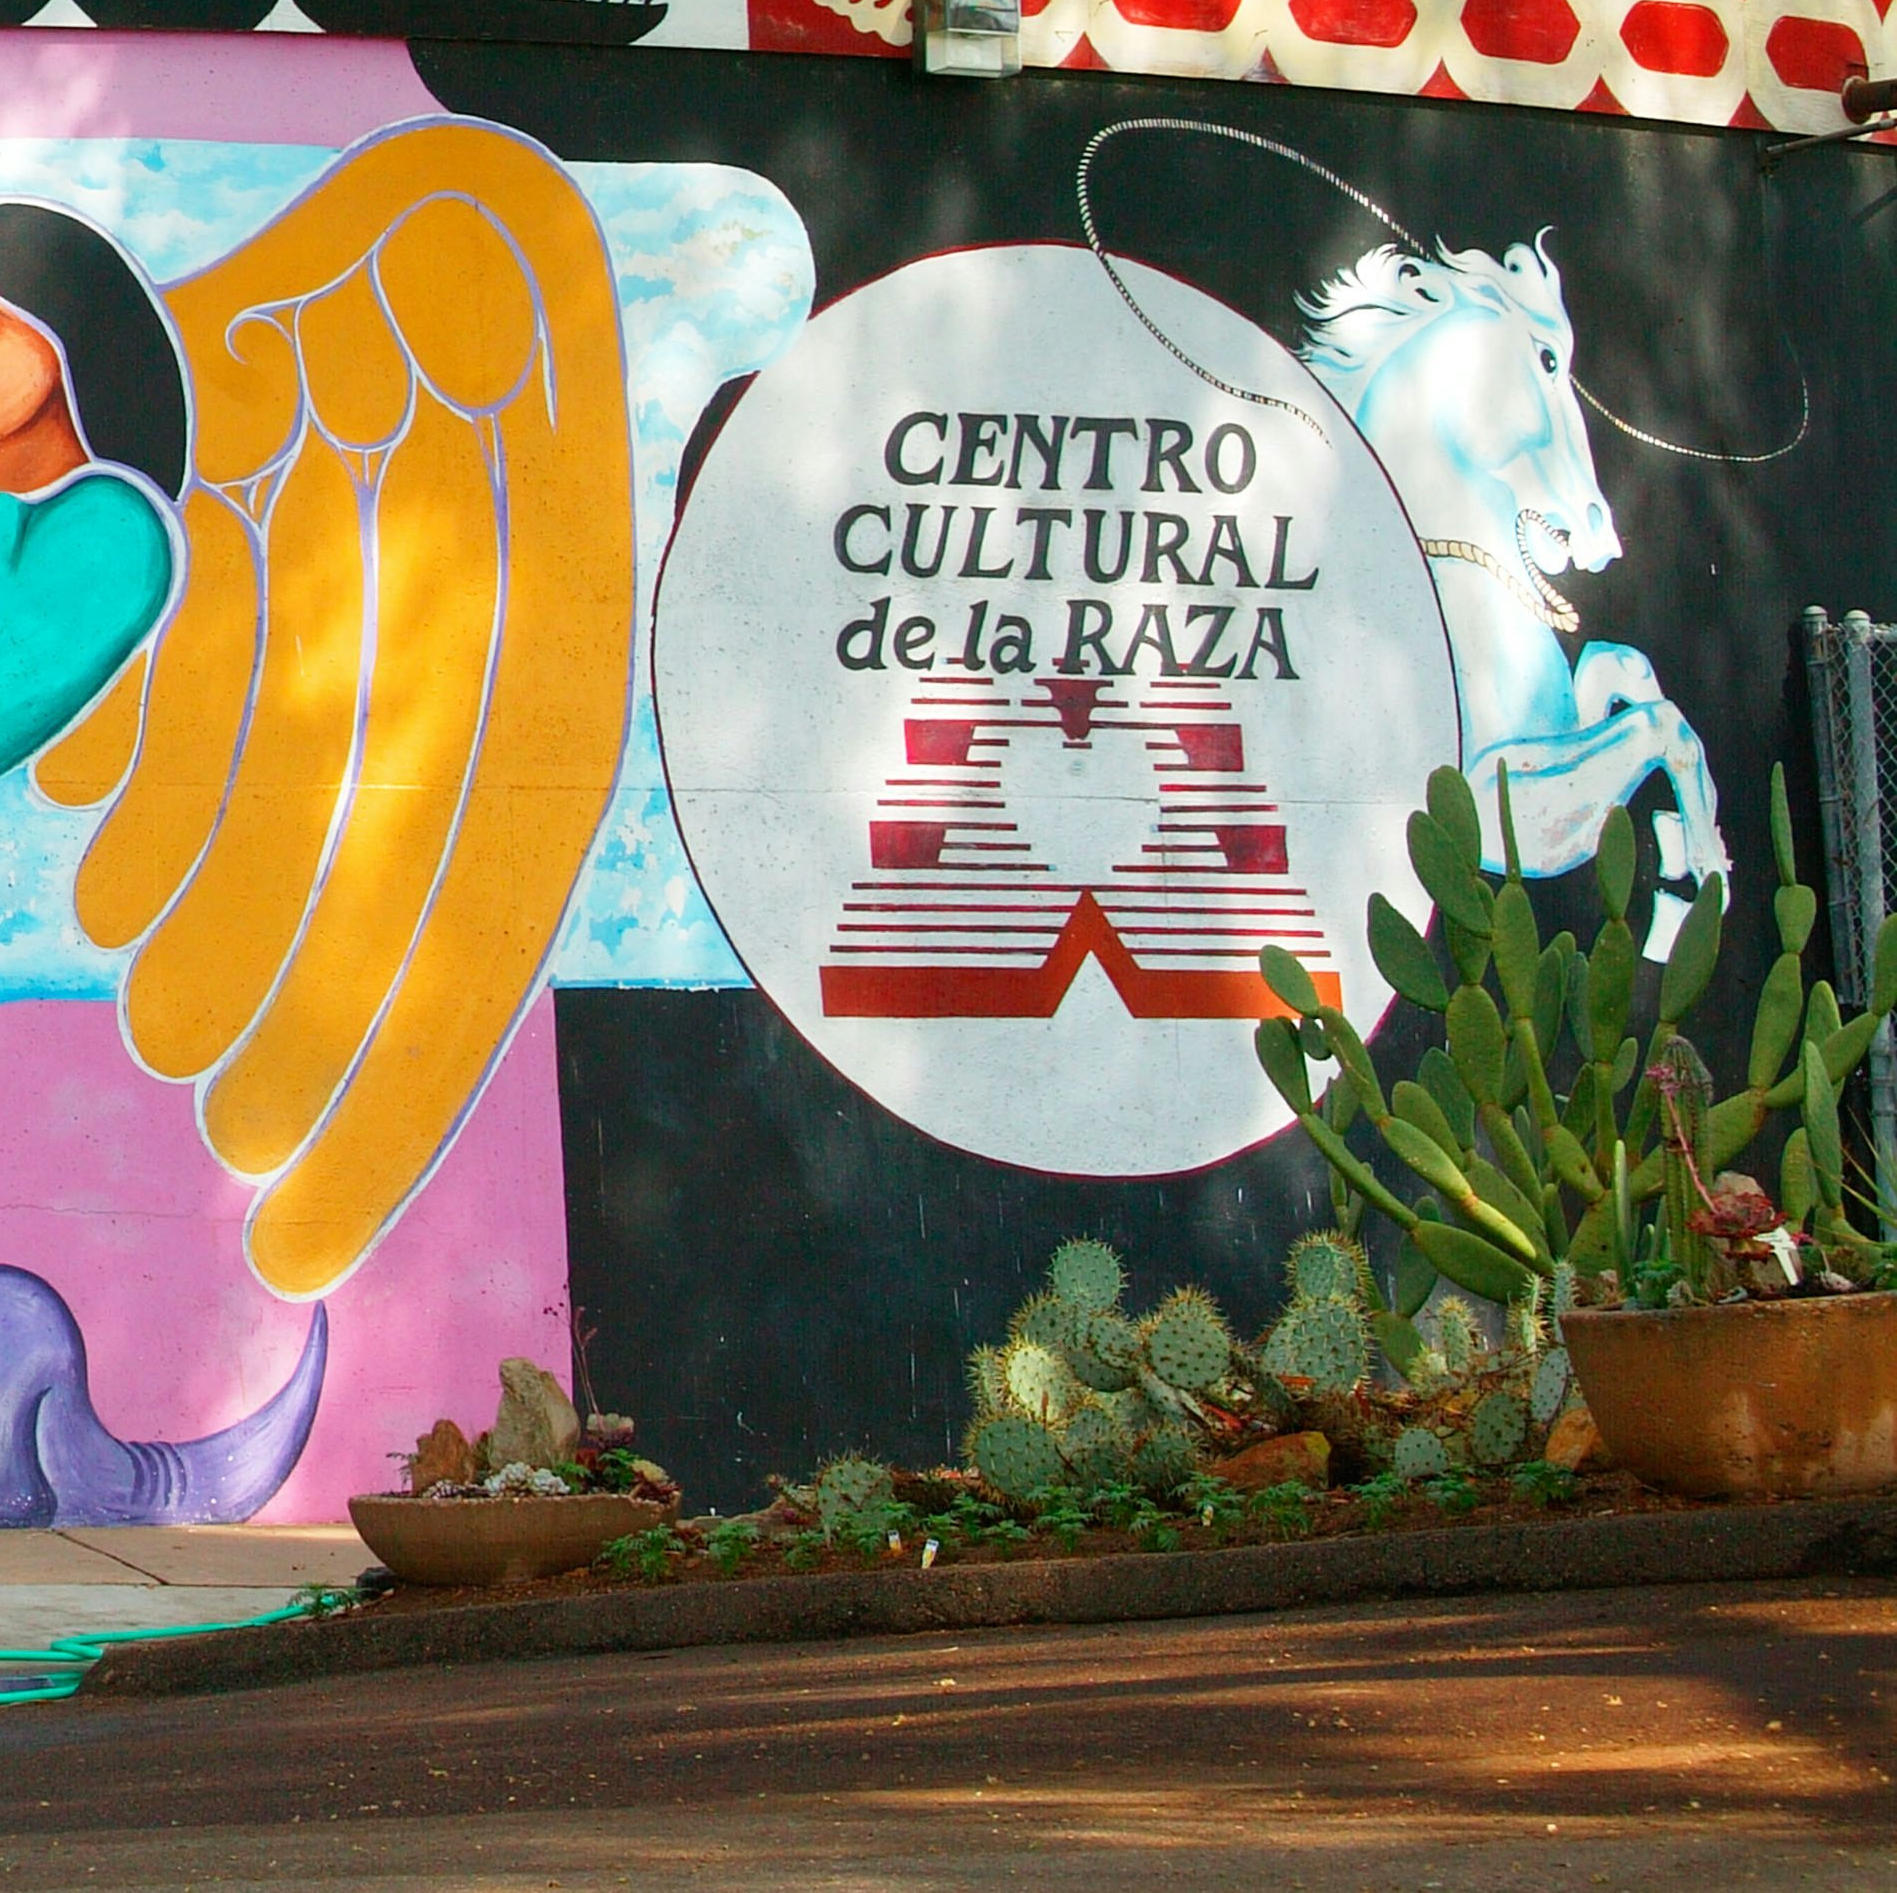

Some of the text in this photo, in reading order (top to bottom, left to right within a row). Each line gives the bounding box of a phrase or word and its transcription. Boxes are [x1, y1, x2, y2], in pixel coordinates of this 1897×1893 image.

[884, 411, 1257, 495] CENTRO
[833, 503, 1320, 591] CULTURAL
[836, 596, 1301, 681] de la RAZA
